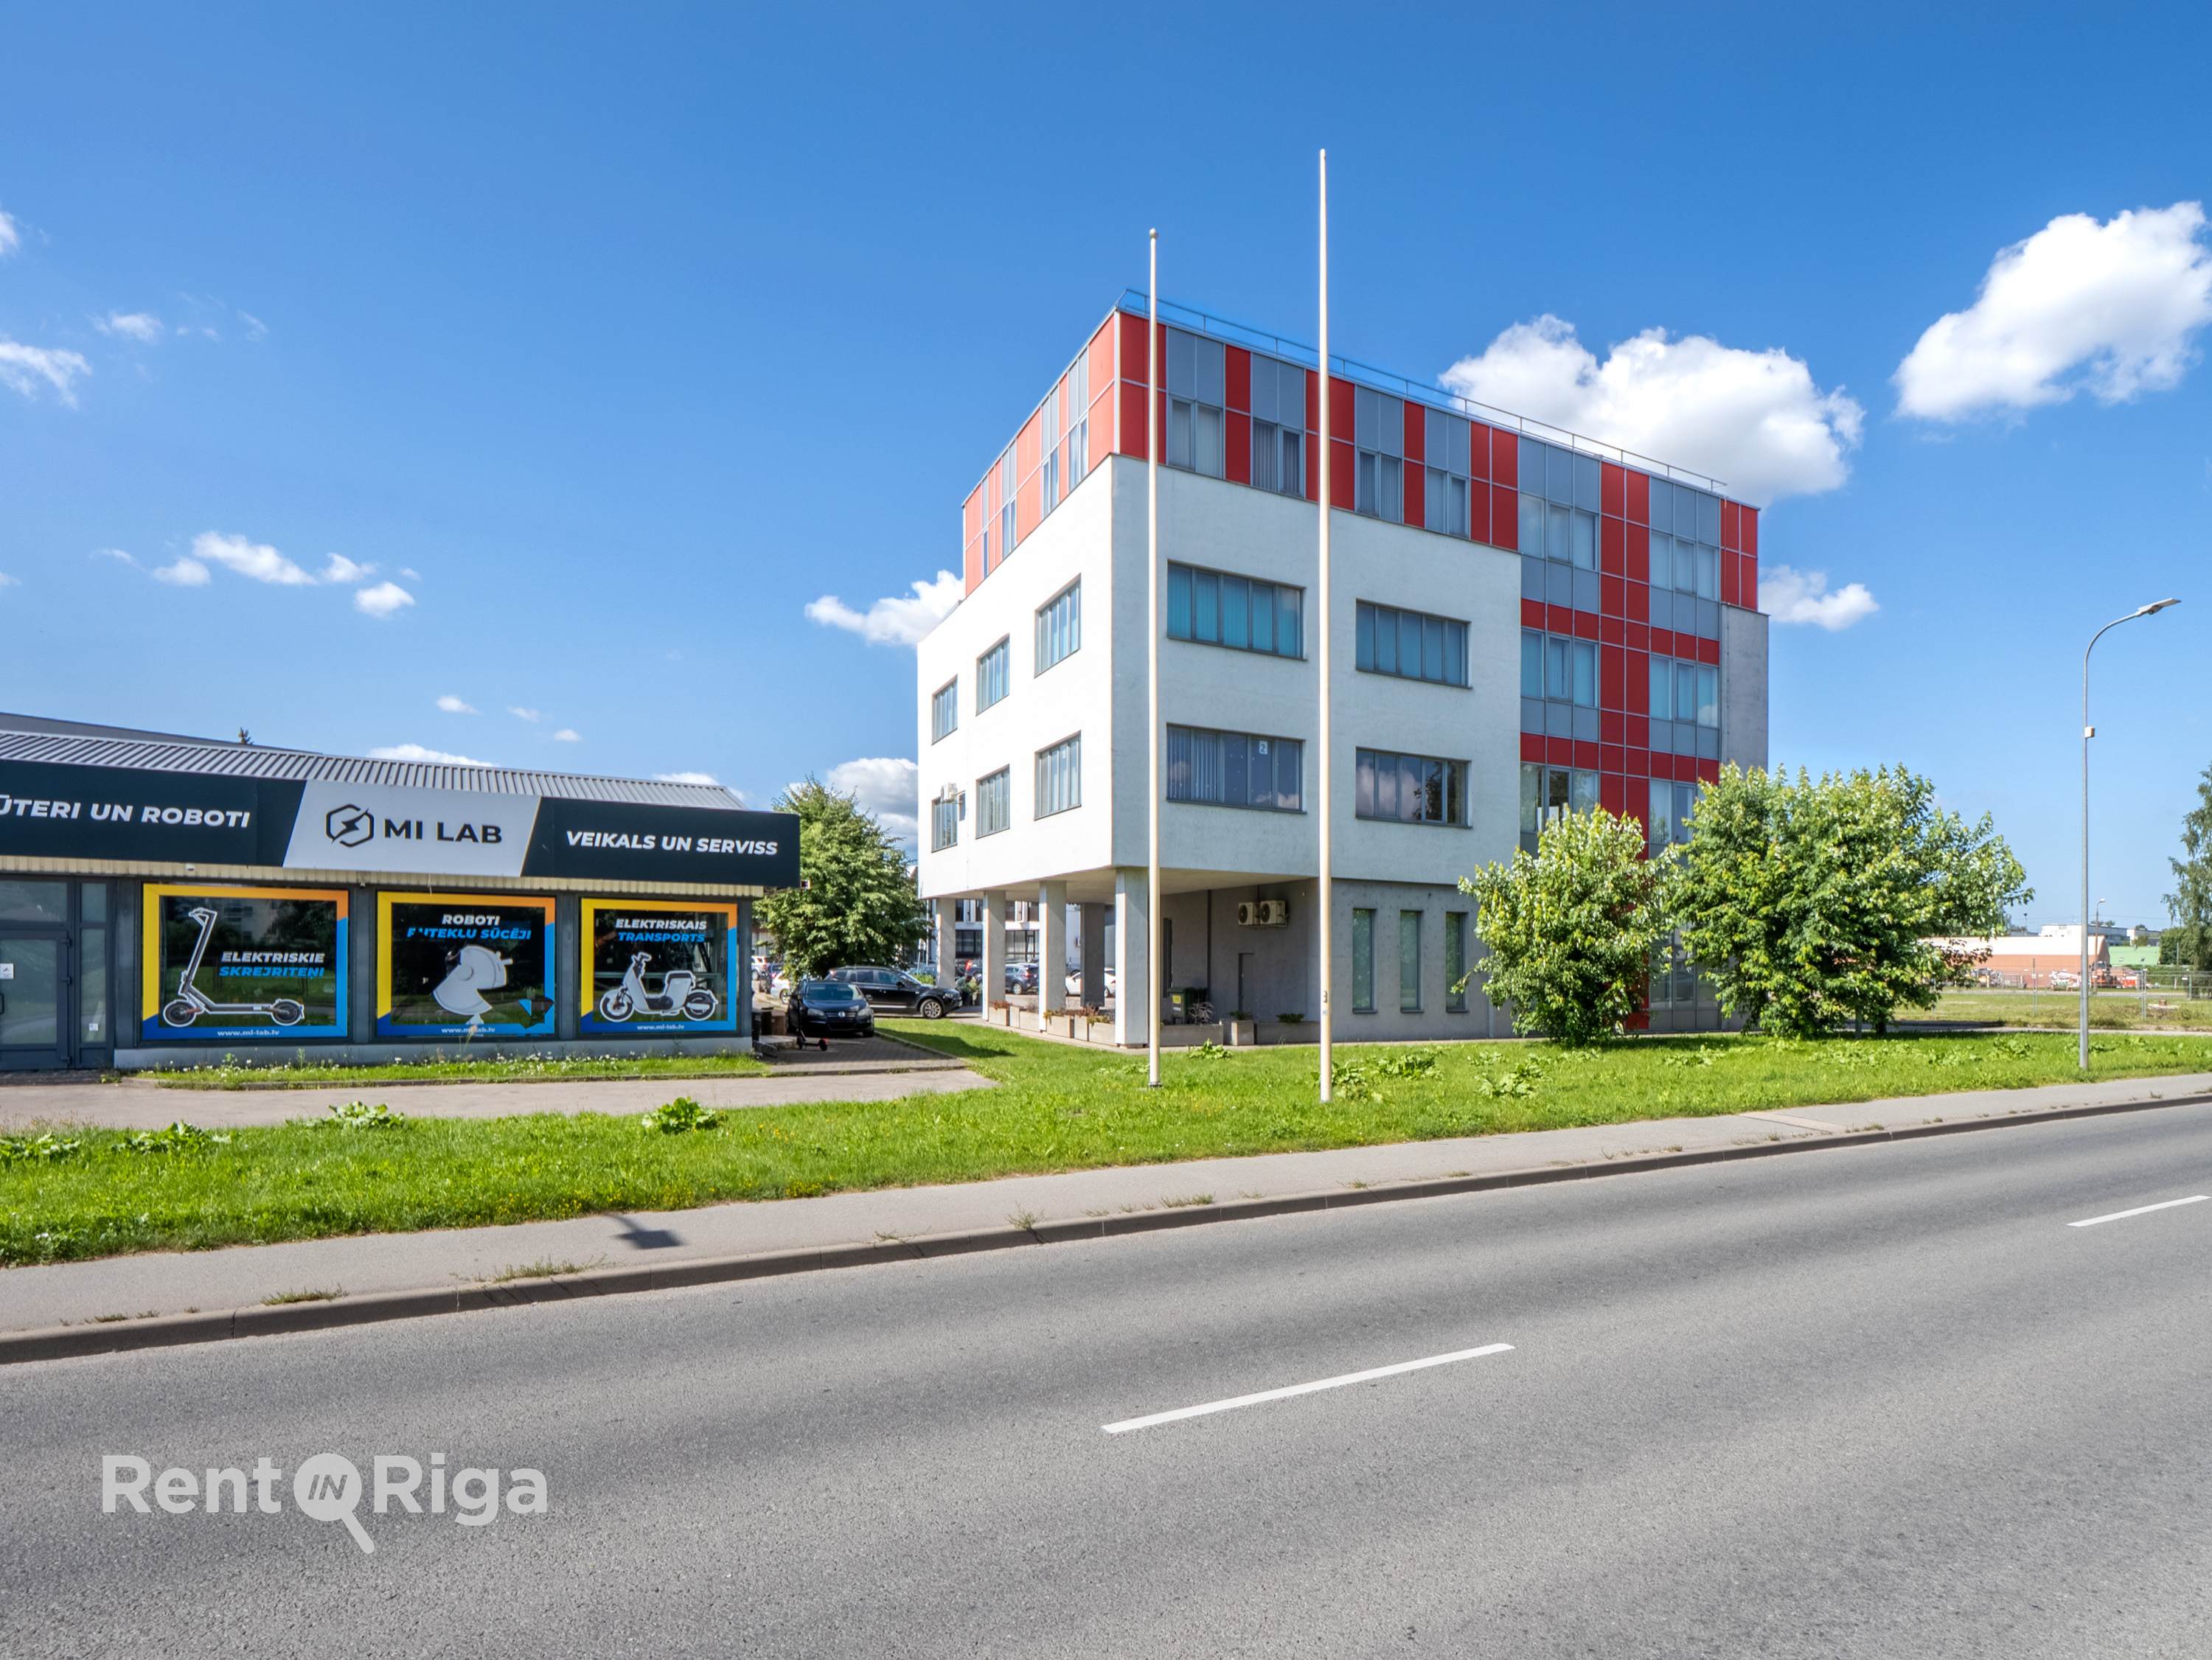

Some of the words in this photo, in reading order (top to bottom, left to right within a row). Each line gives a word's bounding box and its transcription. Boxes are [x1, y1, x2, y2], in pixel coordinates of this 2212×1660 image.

[1261, 744, 1265, 753] 2
[90, 803, 133, 822] UN
[141, 806, 250, 828] ROBOTI
[384, 819, 422, 840] MI
[437, 822, 502, 844] LAB
[566, 831, 655, 849] VEIKALS
[661, 836, 692, 851] UN
[696, 838, 778, 855] SERVISS
[442, 914, 500, 926] ROBOTI
[615, 918, 707, 930] ELEKTRISKAIS
[480, 927, 532, 940] SŪCĒJI
[618, 932, 705, 943] TRANSPORTS
[221, 952, 324, 963] ELEKTRISKIE
[219, 966, 324, 980] SKREJRITEŅI
